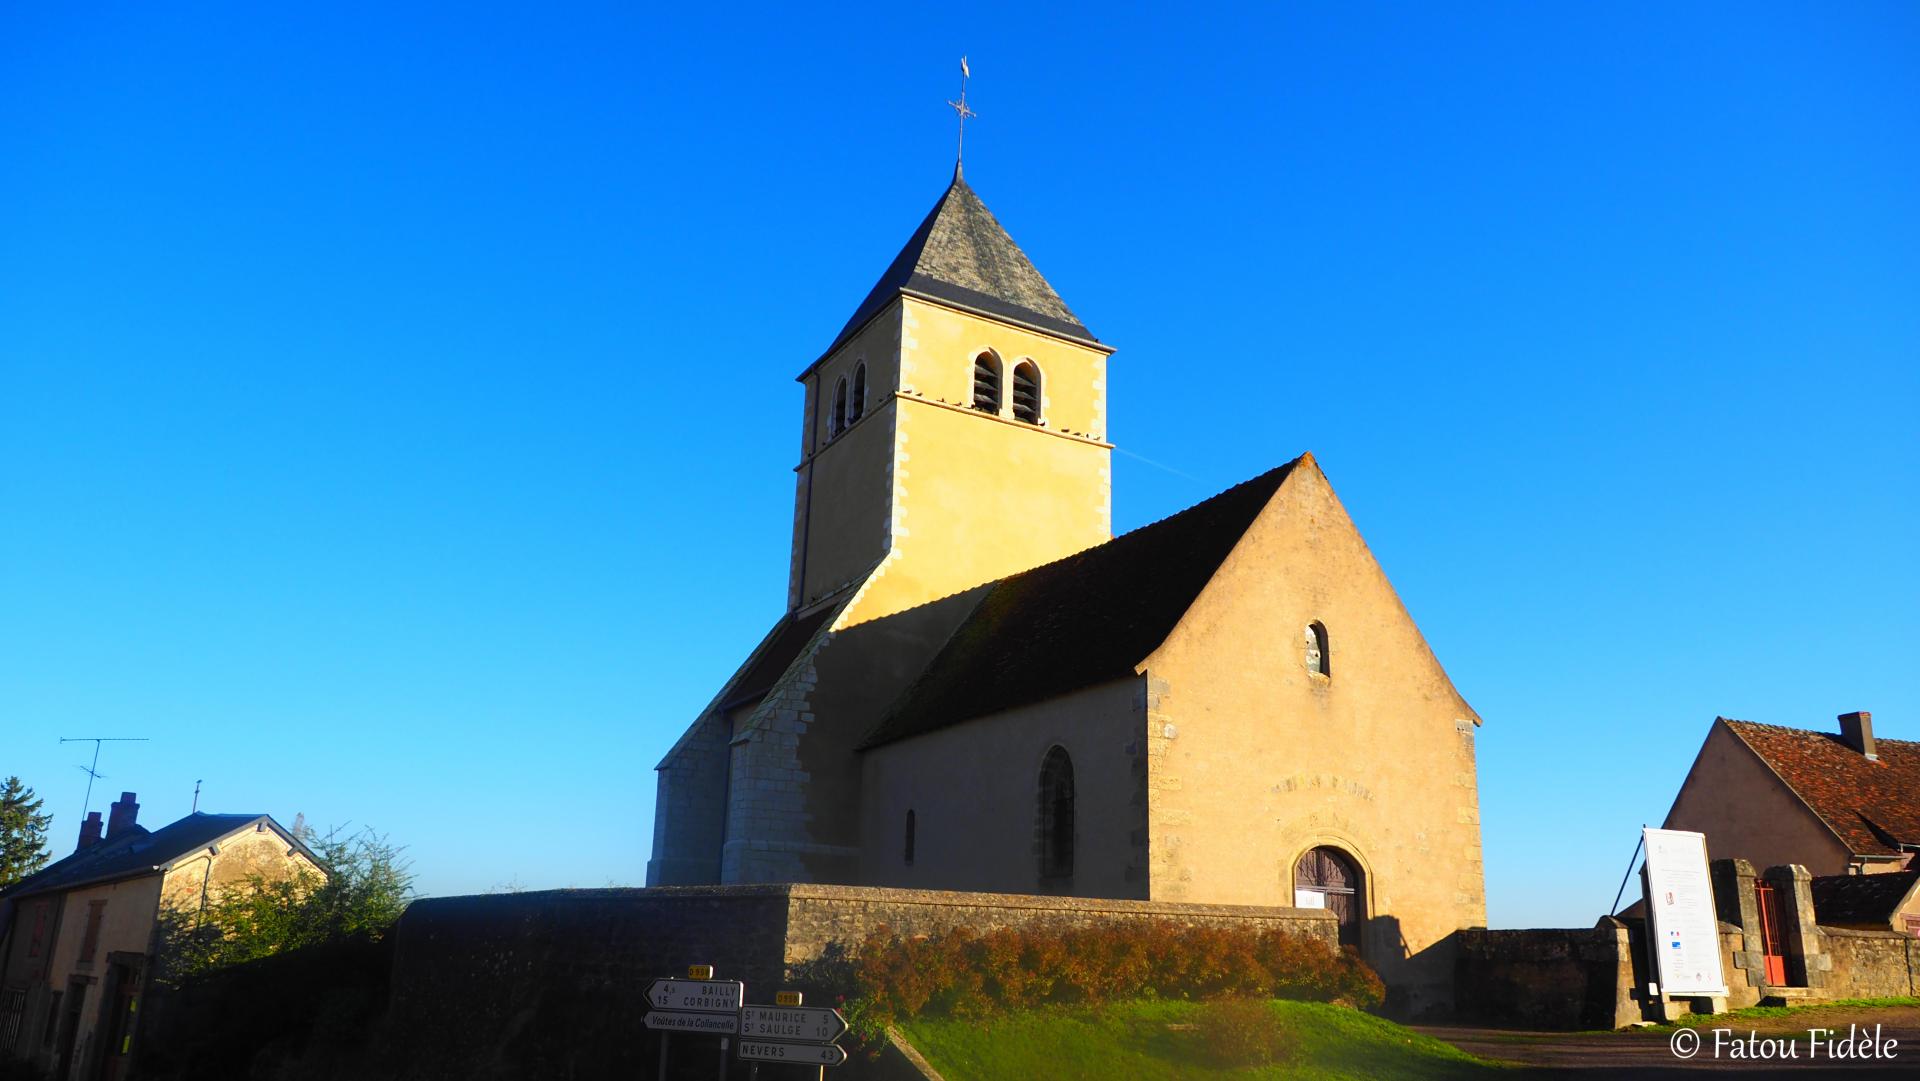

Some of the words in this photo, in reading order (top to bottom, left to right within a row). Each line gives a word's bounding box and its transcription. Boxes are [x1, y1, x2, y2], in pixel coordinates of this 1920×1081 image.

[702, 986, 736, 996] BAILLY
[658, 995, 668, 1004] 15
[683, 997, 735, 1008] CORBIGNY
[652, 1015, 676, 1026] Voûtes
[677, 1017, 686, 1027] de
[687, 1018, 694, 1027] la
[759, 1011, 807, 1024] MAURICE
[823, 1014, 828, 1024] 5
[759, 1023, 801, 1035] SAULGE
[815, 1026, 828, 1036] 10
[742, 1044, 785, 1057] NEVERS
[821, 1050, 834, 1061] 43
